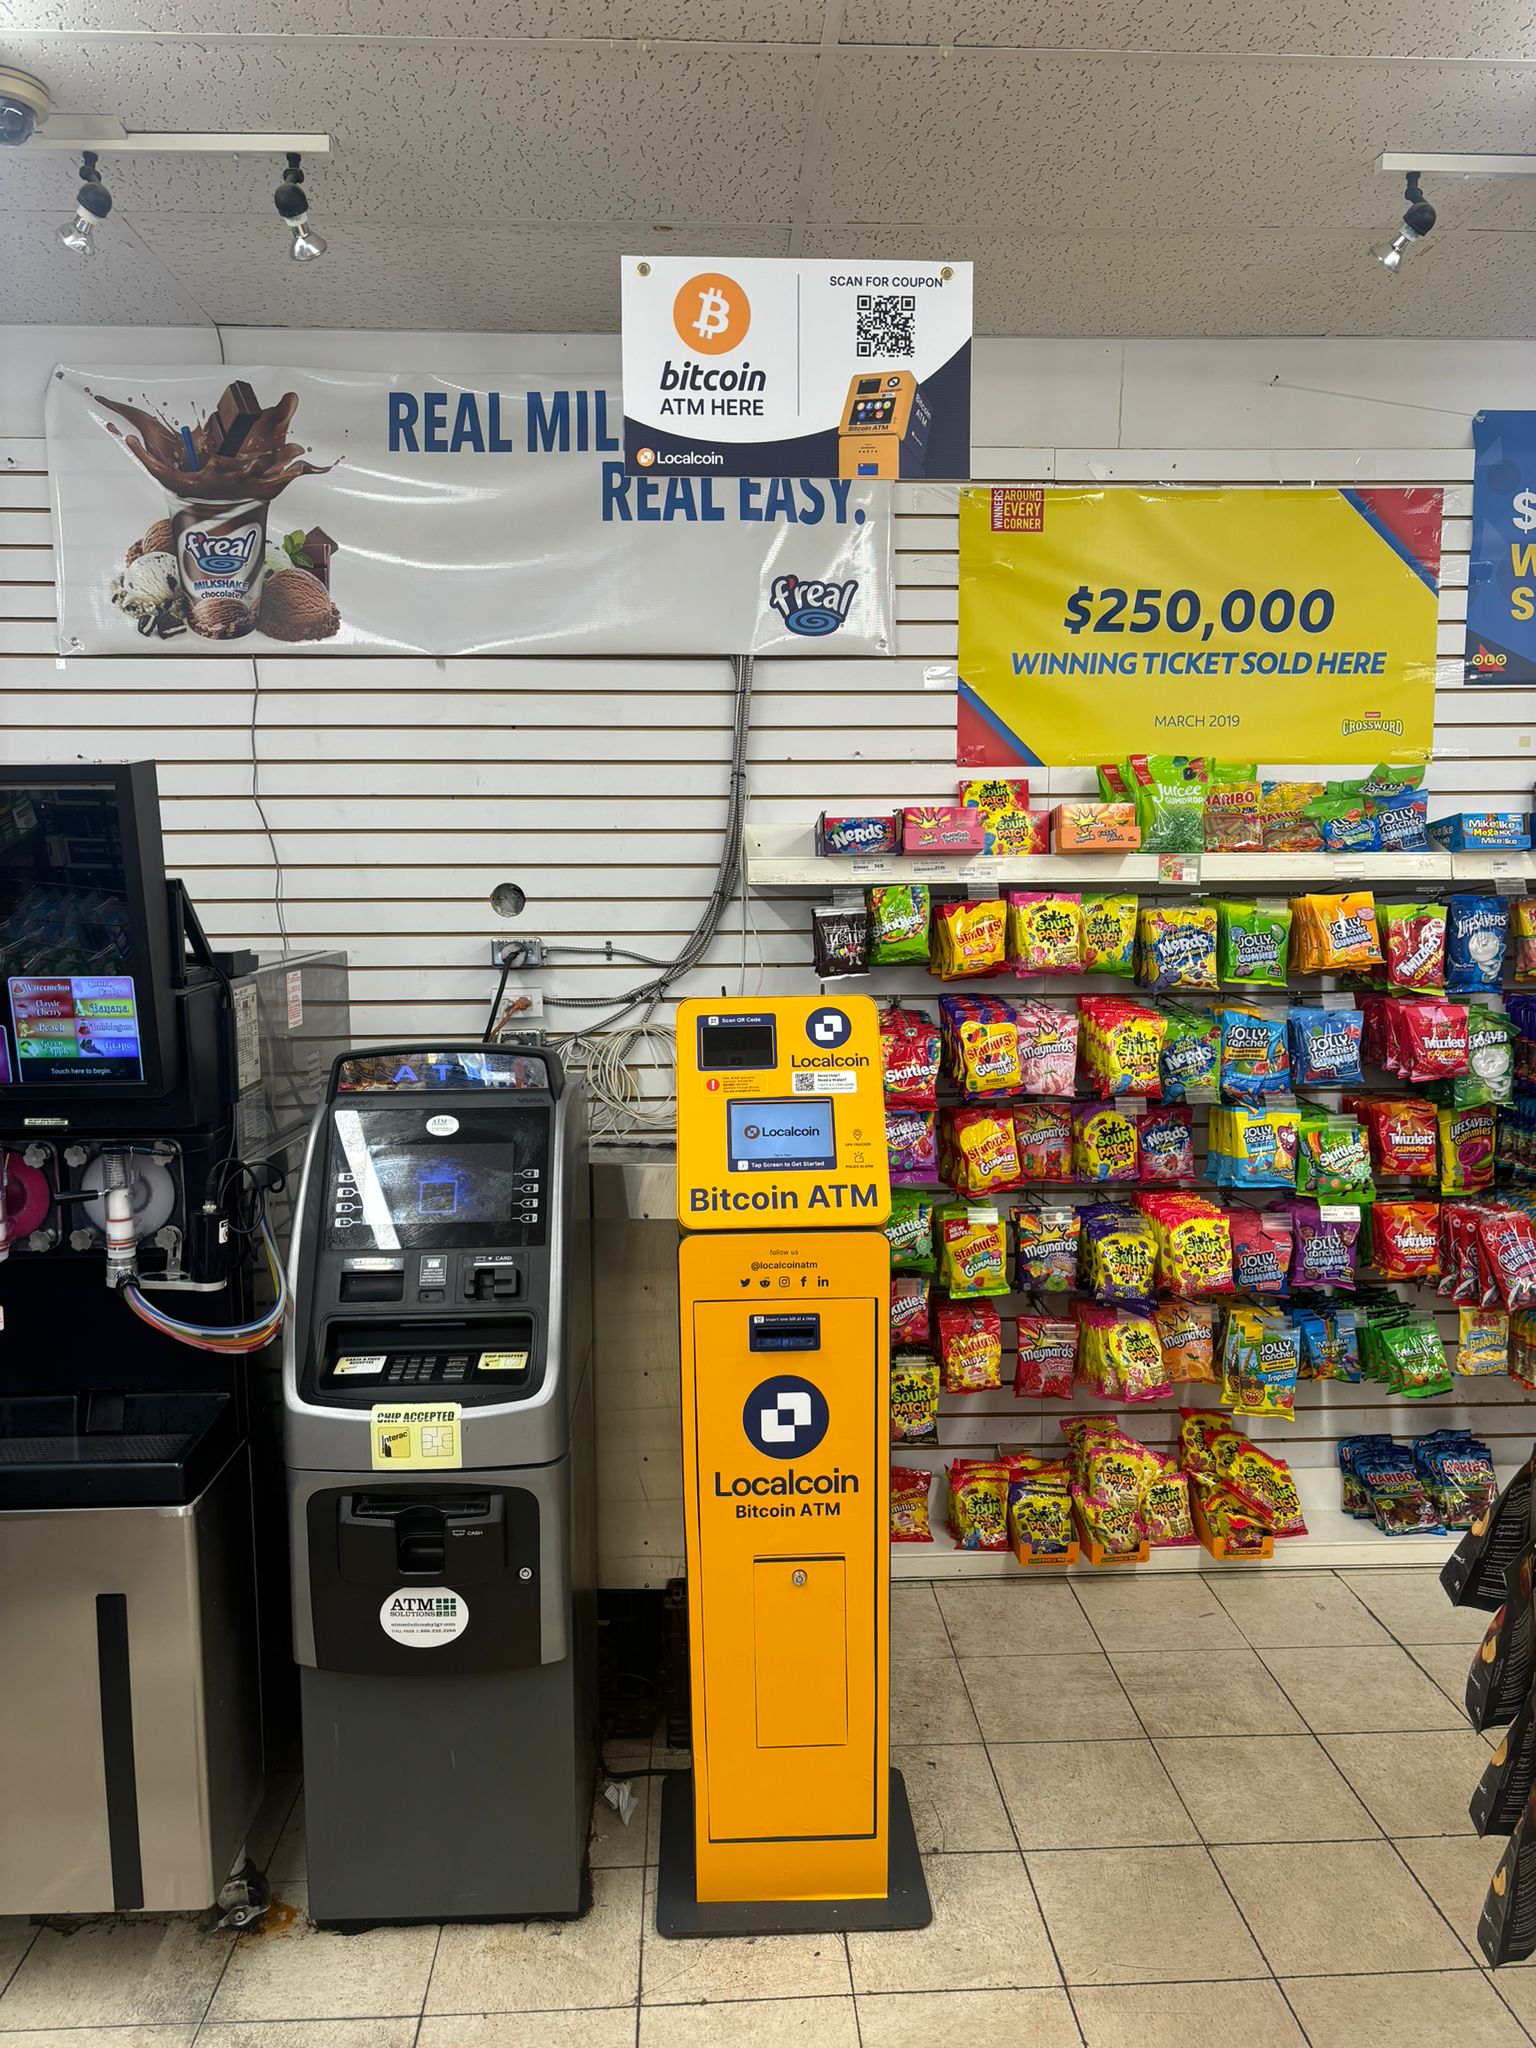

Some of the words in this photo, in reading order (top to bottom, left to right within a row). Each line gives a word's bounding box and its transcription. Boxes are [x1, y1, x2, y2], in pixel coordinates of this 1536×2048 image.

[829, 276, 863, 288] SCAN
[865, 276, 889, 288] FOR
[891, 277, 944, 289] COUPON
[659, 360, 767, 392] bitcoin
[659, 398, 705, 416] ATM
[711, 398, 764, 416] HERE
[388, 391, 512, 453] REAL
[527, 390, 625, 453] MIL
[656, 450, 724, 466] Localcoin
[602, 461, 725, 522] REAL
[739, 477, 866, 526] EASY.
[1004, 489, 1042, 502] AROUND
[993, 489, 1004, 529] WINNERS
[1003, 501, 1042, 517] EVERY
[1003, 517, 1042, 530] CORNER
[193, 579, 249, 592] MILKSHAKE
[200, 590, 241, 600] chocolate
[1063, 586, 1335, 642] $250,000
[1011, 651, 1137, 676] WINNING
[1143, 651, 1240, 676] TICKET
[1241, 651, 1314, 676] SOLD
[1316, 651, 1387, 676] HERE
[1471, 653, 1508, 667] OLG
[1153, 714, 1205, 729] MARCH
[1207, 714, 1241, 729] 2019
[1342, 719, 1404, 737] CROSSWORD
[980, 788, 1008, 797] SOUR
[1155, 781, 1202, 804] Juicee
[979, 796, 1011, 806] PATCH
[1379, 807, 1416, 827] JOLLY
[999, 820, 1028, 831] SOUR
[1468, 819, 1496, 829] Mike
[1498, 820, 1516, 830] Ike
[997, 829, 1028, 839] PATCH
[1473, 828, 1499, 837] Mega
[1481, 837, 1502, 845] Mike
[1036, 917, 1071, 931] SOUR
[1087, 922, 1121, 933] SOUR
[1037, 927, 1075, 943] PATCH
[1087, 931, 1123, 943] PATCH
[1239, 934, 1272, 948] JOLLY
[1240, 943, 1276, 955] rancher
[24, 983, 70, 992] Watermelon
[35, 999, 61, 1008] Classic
[89, 1002, 130, 1014] Banana
[36, 1007, 62, 1018] Cherry
[91, 1022, 134, 1034] Bubblegum
[1228, 1025, 1268, 1040] JOLLY
[104, 1040, 132, 1052] Grape
[1119, 1041, 1157, 1055] SOUR
[1228, 1038, 1270, 1049] rancher
[1311, 1032, 1350, 1052] JOLLY
[1421, 1035, 1467, 1049] Twizzlers
[1021, 1039, 1075, 1061] Maynards
[1313, 1043, 1357, 1059] rancher
[790, 1052, 870, 1068] Localcoin
[1119, 1053, 1159, 1067] PATCH
[93, 1068, 112, 1076] begin.
[885, 1063, 938, 1083] Skittles
[761, 1125, 821, 1137] Localcoin
[1096, 1129, 1131, 1147] SOUR
[1147, 1125, 1190, 1148] Nerds
[1243, 1124, 1273, 1139] JOLLY
[1454, 1126, 1492, 1146] Gummies
[1388, 1132, 1434, 1146] Twizzlers
[1098, 1141, 1135, 1159] PATCH
[1319, 1142, 1364, 1167] Skittles
[802, 1160, 825, 1168] Started
[689, 1185, 799, 1213] Bitcoin
[807, 1183, 879, 1209] ATM
[883, 1217, 929, 1241] Skittles
[953, 1234, 1000, 1263] Starburst
[1023, 1237, 1079, 1259] Maynards
[1184, 1240, 1222, 1254] SOUR
[1305, 1237, 1341, 1251] JOLLY
[1113, 1254, 1148, 1264] SOUR
[1185, 1250, 1226, 1266] PATCH
[1308, 1247, 1346, 1258] rancher
[750, 1260, 818, 1272] @localcoinatm
[1241, 1252, 1276, 1268] JOLLY
[1112, 1262, 1148, 1276] PATCH
[1243, 1263, 1278, 1276] rancher
[892, 1303, 927, 1324] Gummies
[1125, 1338, 1152, 1351] SOUR
[1162, 1327, 1212, 1350] Maynards
[1020, 1344, 1075, 1363] Maynards
[1259, 1340, 1293, 1355] JOLLY
[1129, 1349, 1159, 1362] PATCH
[1261, 1350, 1295, 1361] rancher
[1267, 1371, 1294, 1383] Tropical
[892, 1389, 928, 1404] SOUR
[892, 1401, 930, 1415] PATCH
[376, 1411, 402, 1424] CHIP
[402, 1410, 455, 1423] ACCEPTED
[1442, 1458, 1491, 1474] HARIBO
[714, 1467, 860, 1498] Localcoin
[1103, 1473, 1137, 1486] PATCH
[1366, 1472, 1416, 1486] HARIBO
[1150, 1491, 1179, 1504] SOUR
[734, 1503, 797, 1519] Bitcoin
[799, 1502, 841, 1518] ATM
[967, 1503, 1000, 1514] SOUR
[1152, 1501, 1184, 1514] PATCH
[390, 1597, 436, 1612] ATM
